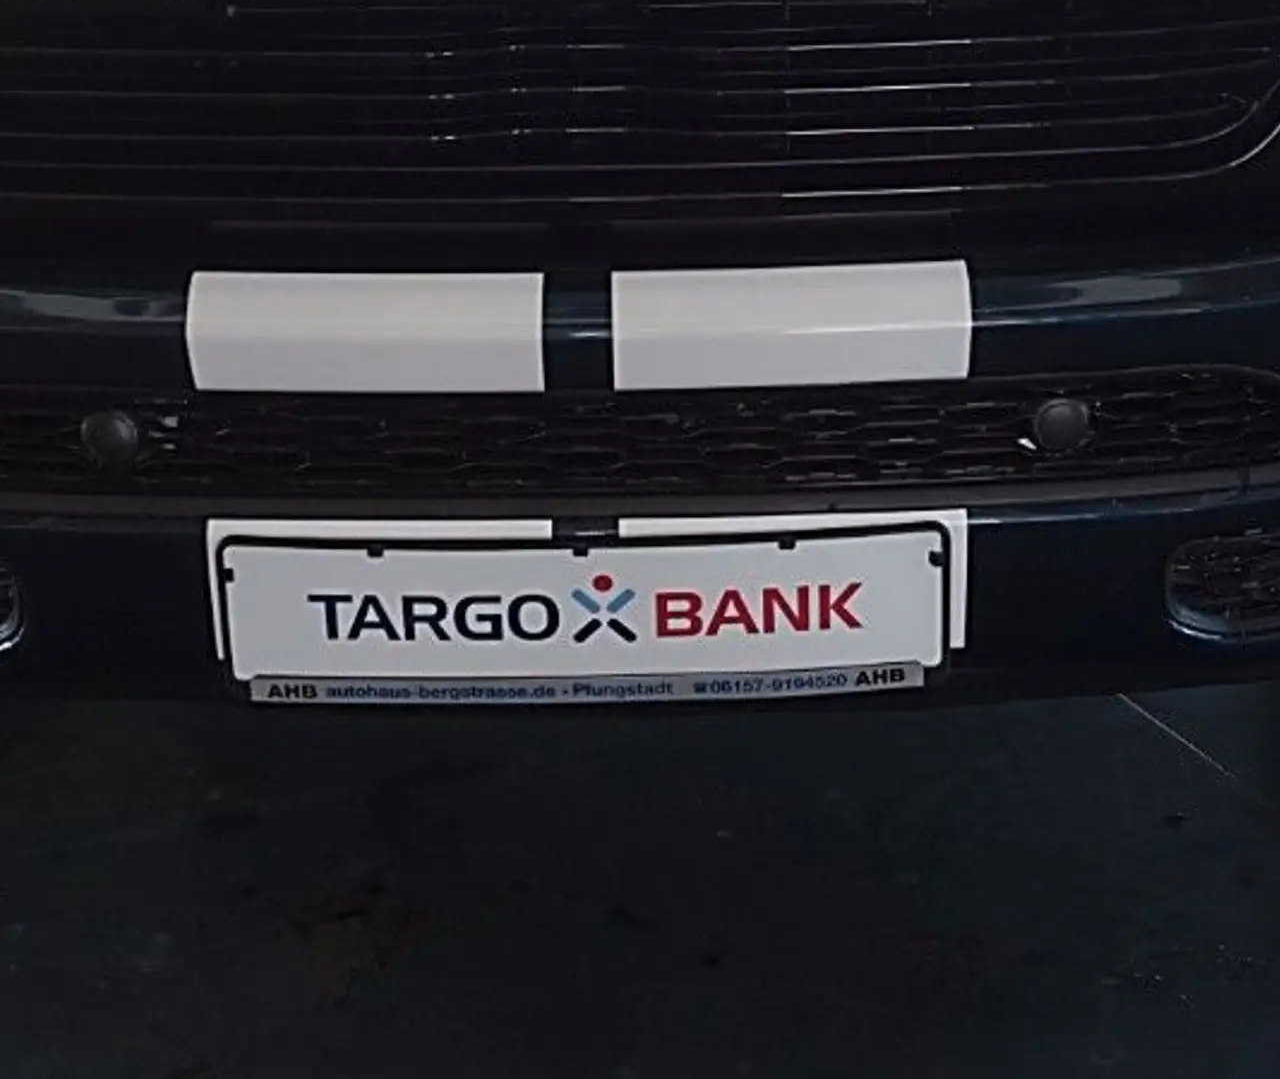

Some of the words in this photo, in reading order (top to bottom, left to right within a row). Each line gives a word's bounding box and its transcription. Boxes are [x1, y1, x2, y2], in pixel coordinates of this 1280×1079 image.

[308, 594, 560, 641] TARGO
[655, 582, 862, 638] BANK
[267, 684, 317, 699] AHB
[326, 683, 556, 702] autohaus-bergstrasse.de
[855, 668, 905, 686] AHB
